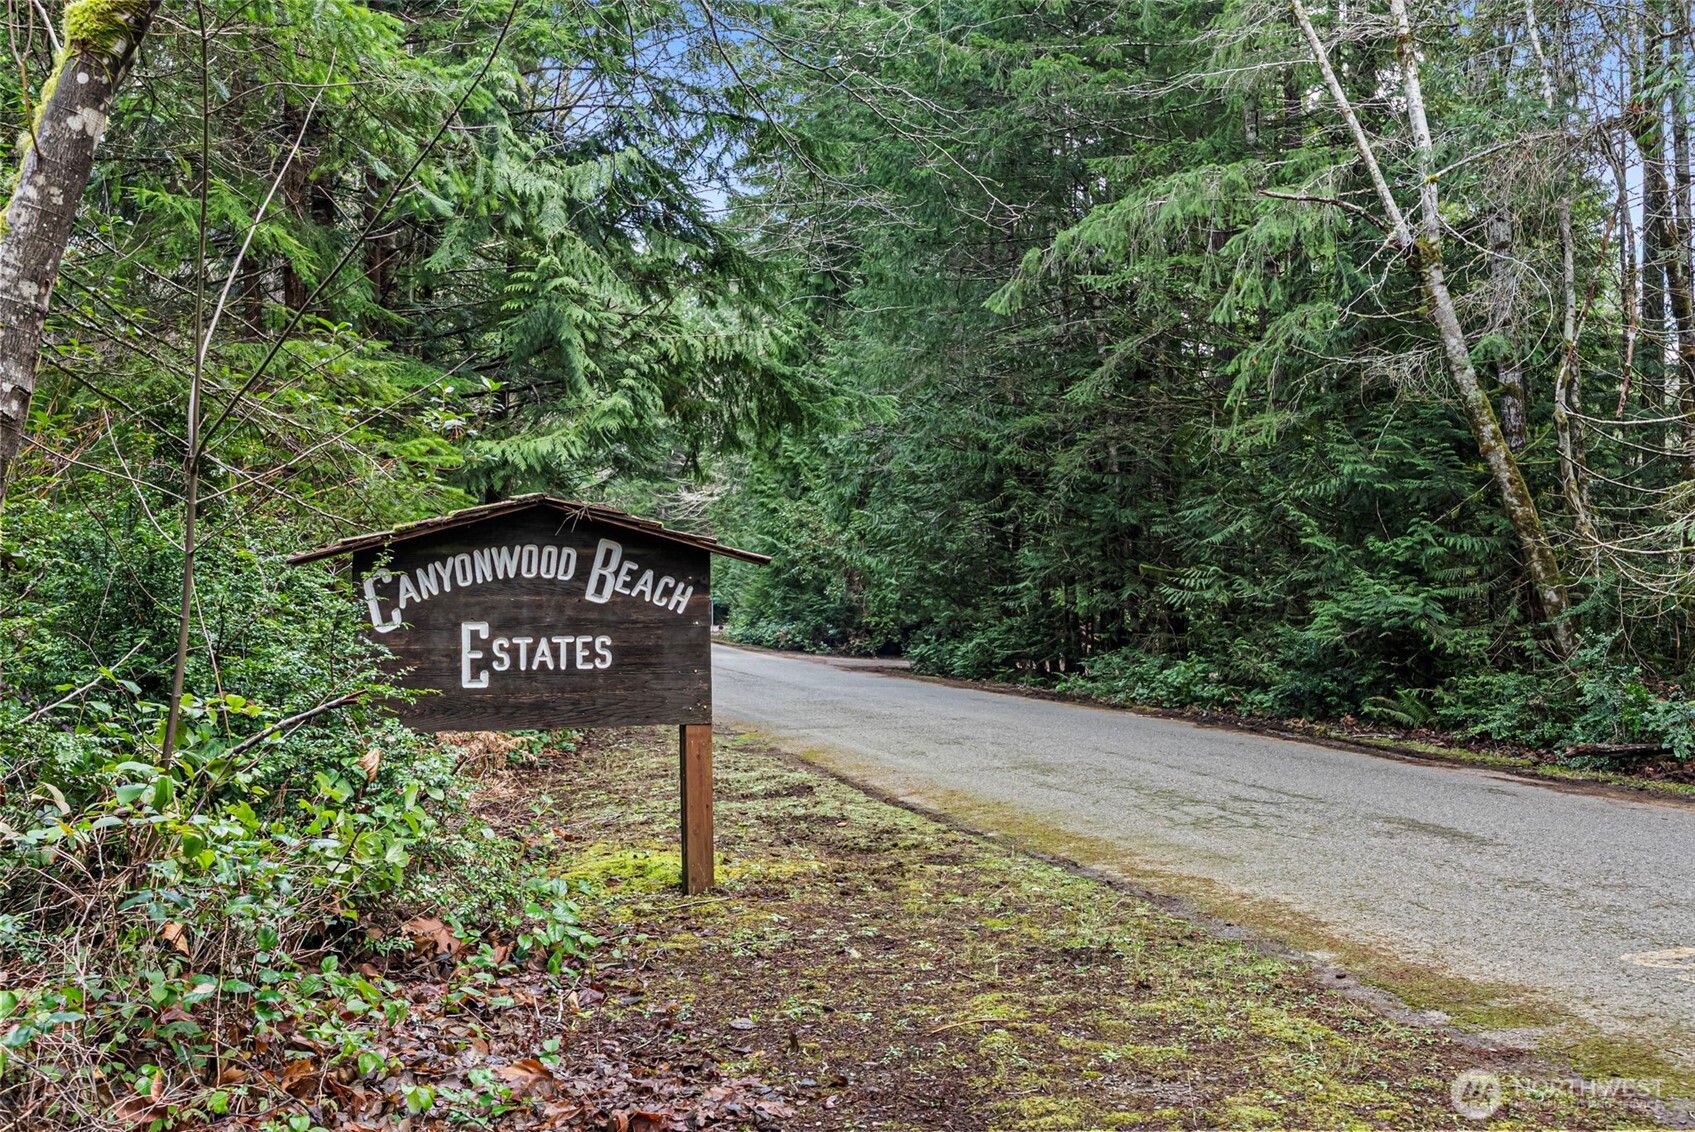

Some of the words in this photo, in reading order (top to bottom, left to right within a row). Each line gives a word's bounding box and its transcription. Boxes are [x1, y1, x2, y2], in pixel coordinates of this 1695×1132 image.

[363, 543, 577, 633] CANYONWOOD
[585, 538, 694, 615] BEACH
[461, 621, 613, 689] ESTATES
